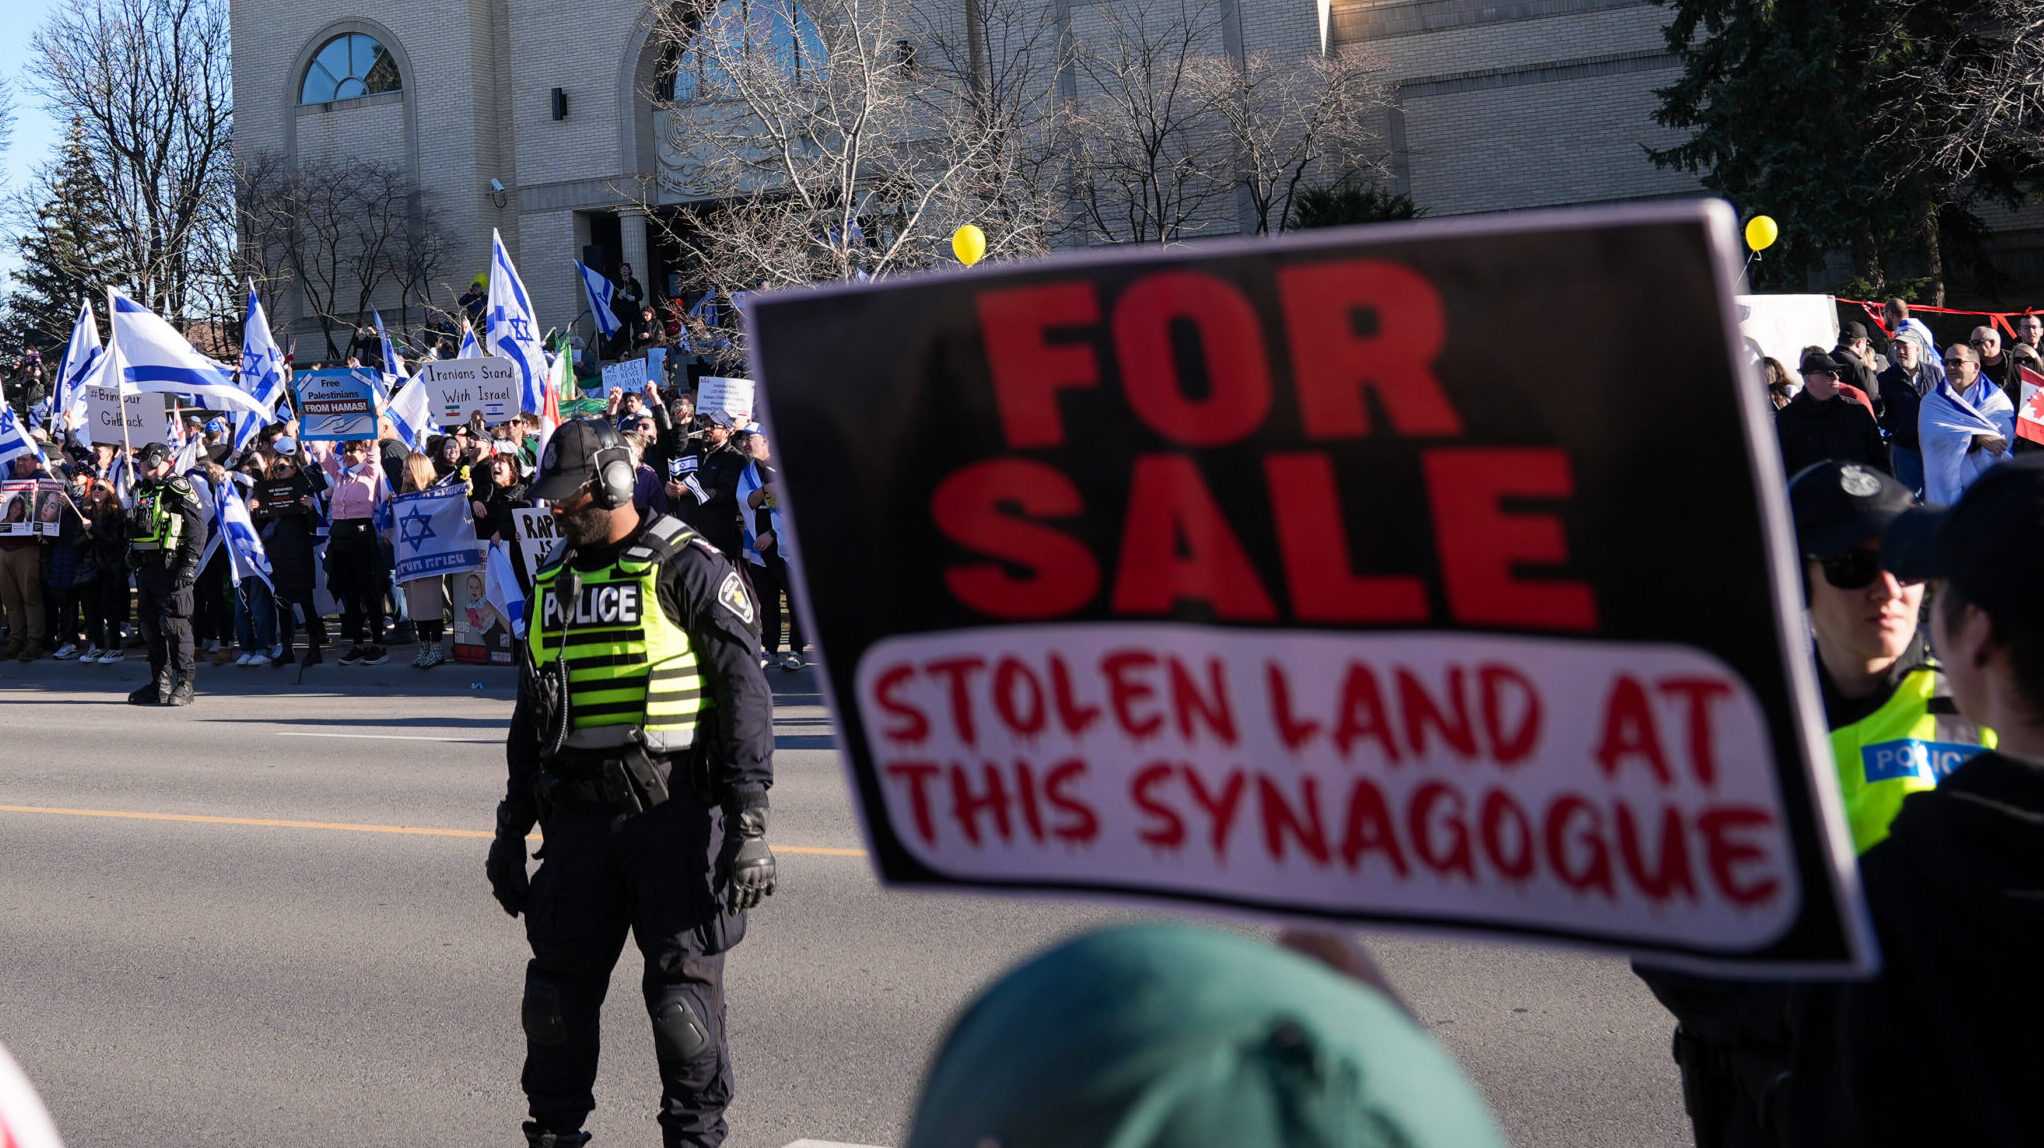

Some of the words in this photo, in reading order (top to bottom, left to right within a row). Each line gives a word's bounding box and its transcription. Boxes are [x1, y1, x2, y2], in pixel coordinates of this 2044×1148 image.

[976, 257, 1466, 449] FOR
[427, 365, 476, 382] Iranians
[481, 365, 513, 379] Stand
[304, 404, 330, 413] FROM
[331, 401, 367, 411] HAMAS!
[308, 390, 360, 400] Palestinians
[442, 388, 471, 404] With
[478, 385, 511, 401] Israel
[540, 540, 553, 554] IS
[930, 446, 1600, 632] SALE
[544, 585, 637, 627] POLICE
[872, 647, 1240, 751] STOLEN
[1265, 659, 1543, 770] LAND
[1594, 668, 1736, 792] AT
[885, 758, 1100, 850] THIS
[1130, 759, 1782, 910] SYNAGOGUE
